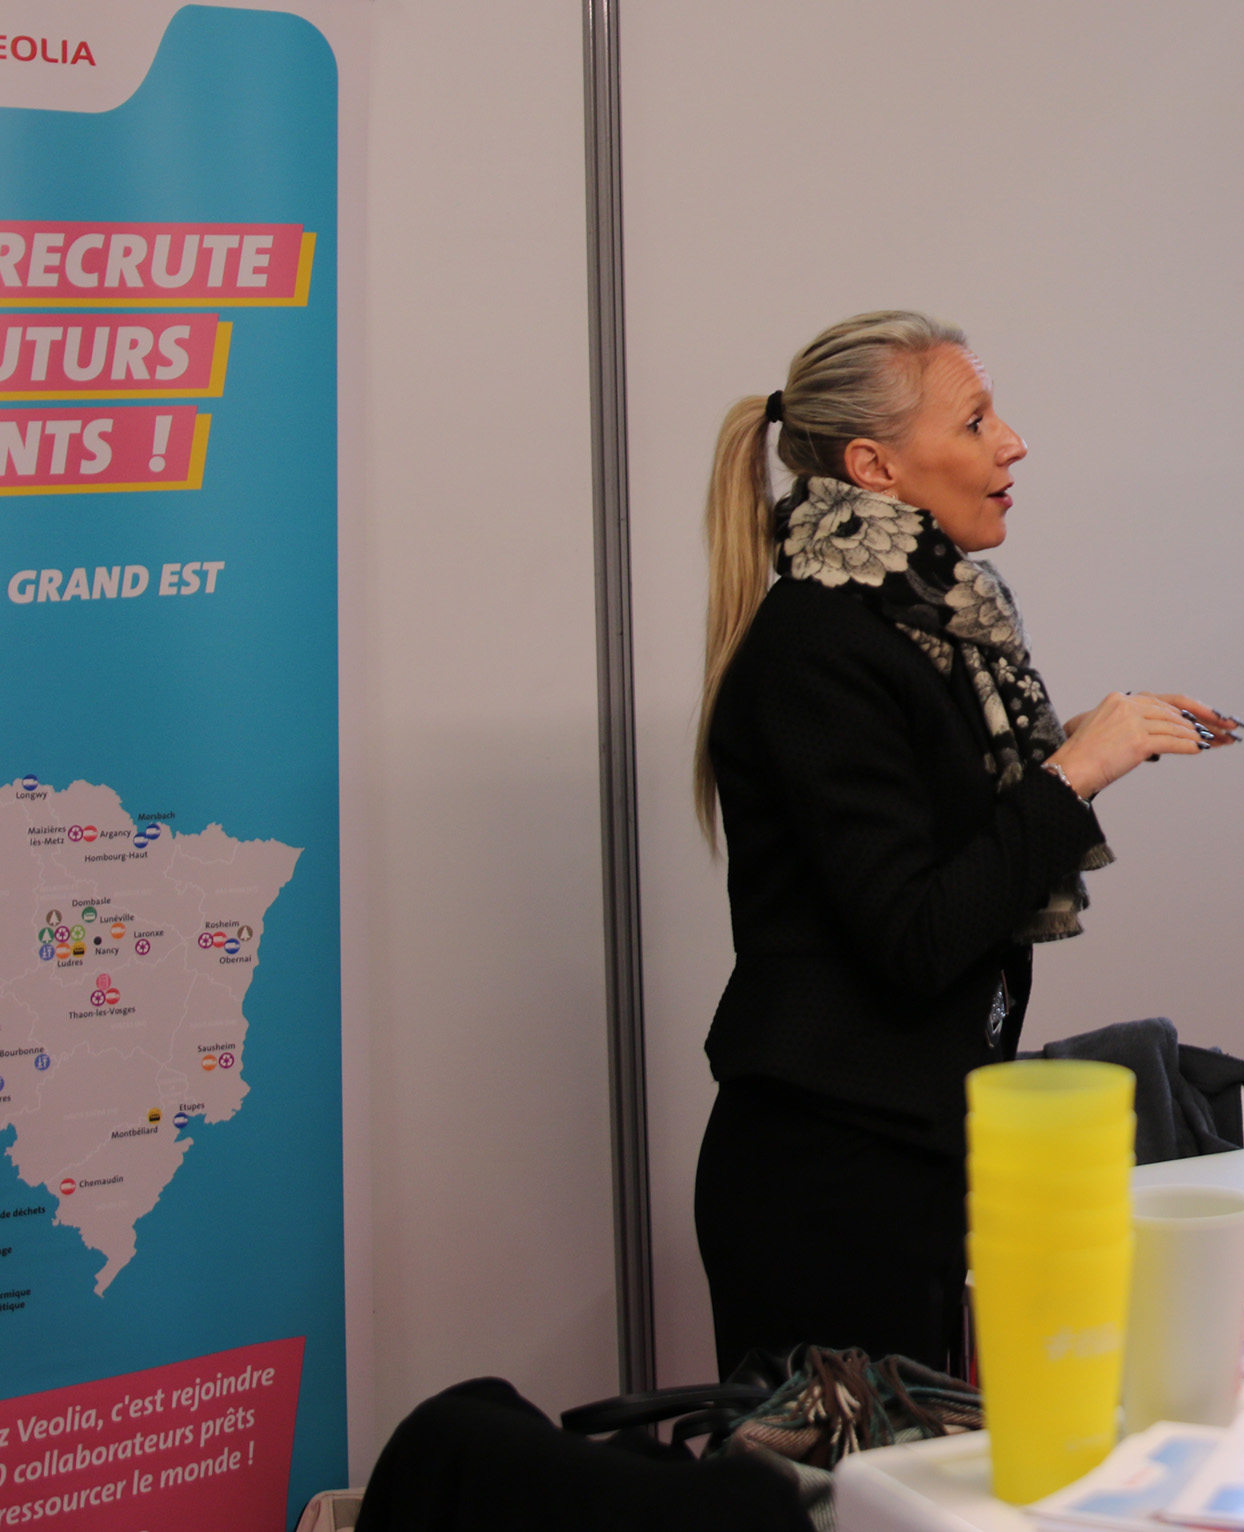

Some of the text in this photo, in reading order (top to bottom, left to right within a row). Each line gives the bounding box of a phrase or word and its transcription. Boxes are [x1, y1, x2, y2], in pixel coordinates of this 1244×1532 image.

[0, 232, 274, 289] RECRUTE
[0, 415, 173, 476] NTS !
[7, 560, 225, 604] GRAND EST
[16, 791, 48, 800] Longwy
[138, 811, 176, 821] Morsbach
[100, 829, 131, 839] Argancy
[84, 851, 148, 863] Hombourg-Haut
[71, 897, 111, 907] Dombasle
[205, 920, 240, 929] Rosheim
[95, 947, 119, 956] Nancy
[57, 958, 83, 967] Ludres
[219, 955, 252, 964] Obernai
[68, 1005, 136, 1020] Thaon-les-Vosges
[197, 1042, 236, 1053] Sausheim
[111, 1126, 158, 1139] Montbéliard
[79, 1174, 124, 1188] Chemaudin
[17, 1405, 104, 1443] Veolia,
[111, 1389, 165, 1422] c'est
[171, 1365, 275, 1411] rejoindre
[13, 1425, 194, 1484] collaborateurs
[200, 1406, 255, 1448] prêts
[132, 1470, 153, 1495] le
[159, 1448, 242, 1488] monde
[247, 1441, 255, 1465] !
